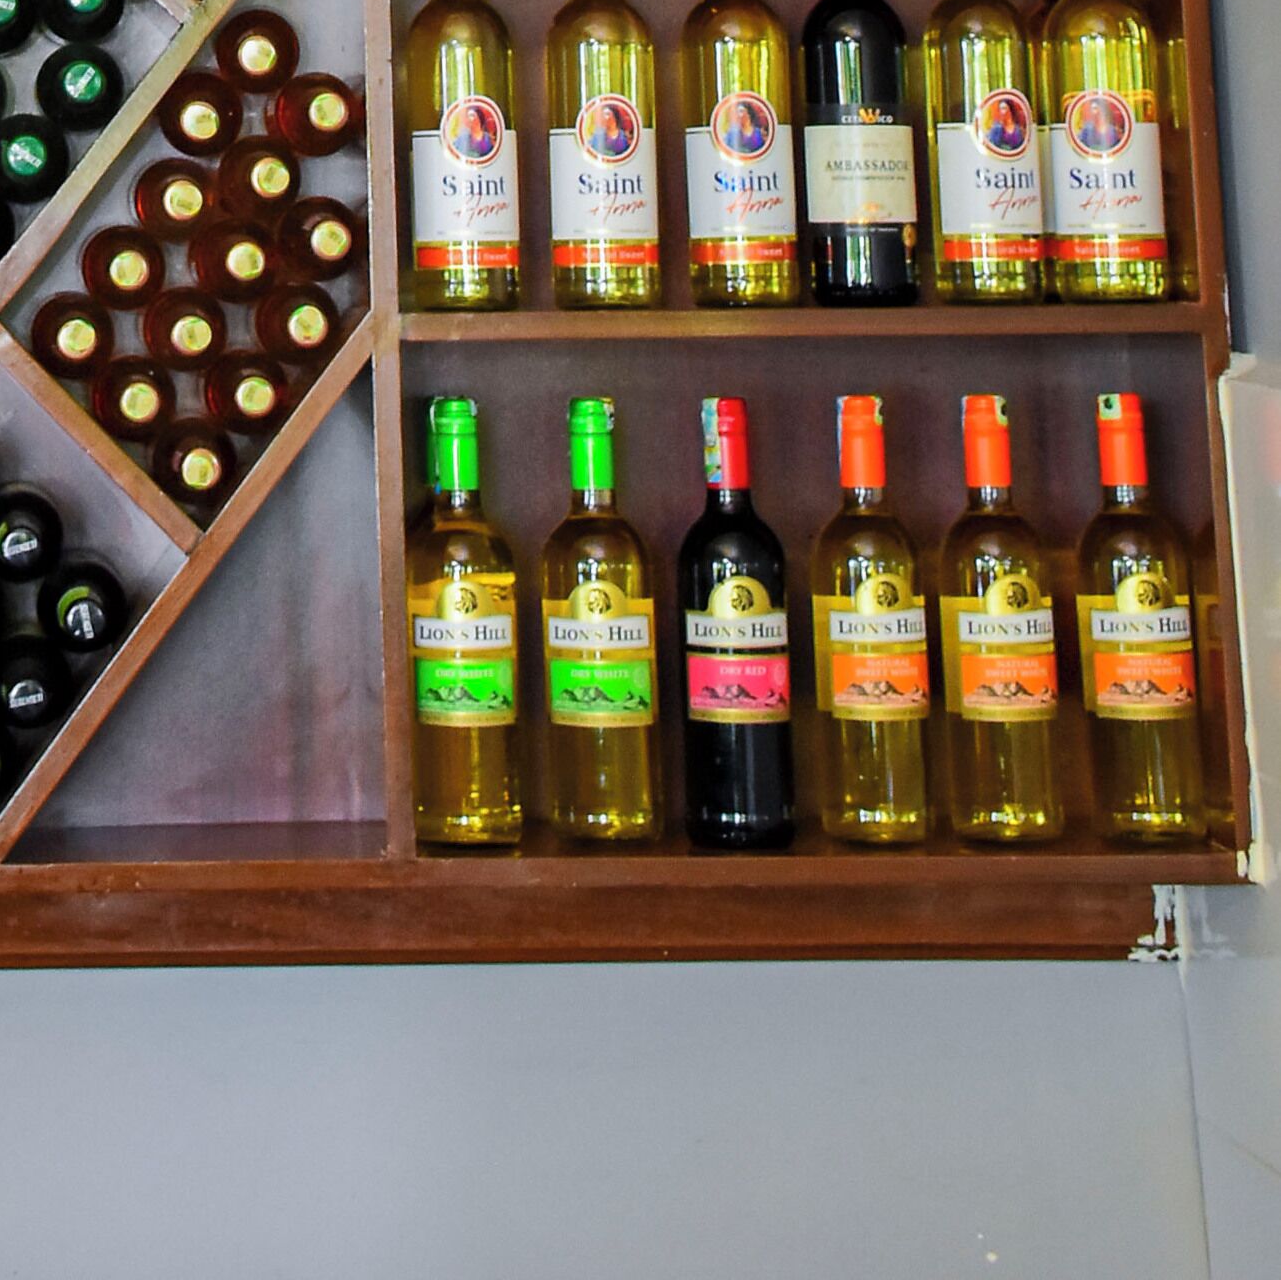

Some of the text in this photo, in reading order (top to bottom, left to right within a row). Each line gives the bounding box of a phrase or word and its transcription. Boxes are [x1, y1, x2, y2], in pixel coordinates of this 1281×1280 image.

[442, 173, 506, 196] Saint
[578, 172, 643, 195] Saint
[714, 170, 780, 192] Saint
[976, 167, 1035, 190] Saint
[1069, 167, 1137, 190] Sant
[1111, 246, 1140, 254] weet
[419, 624, 469, 641] LIONS
[554, 625, 603, 641] LIONS
[694, 622, 746, 638] LION'S
[838, 620, 893, 634] LION'S
[968, 619, 1021, 635] LION'S
[1099, 619, 1153, 634] LION'S
[720, 666, 766, 676] DRY RED
